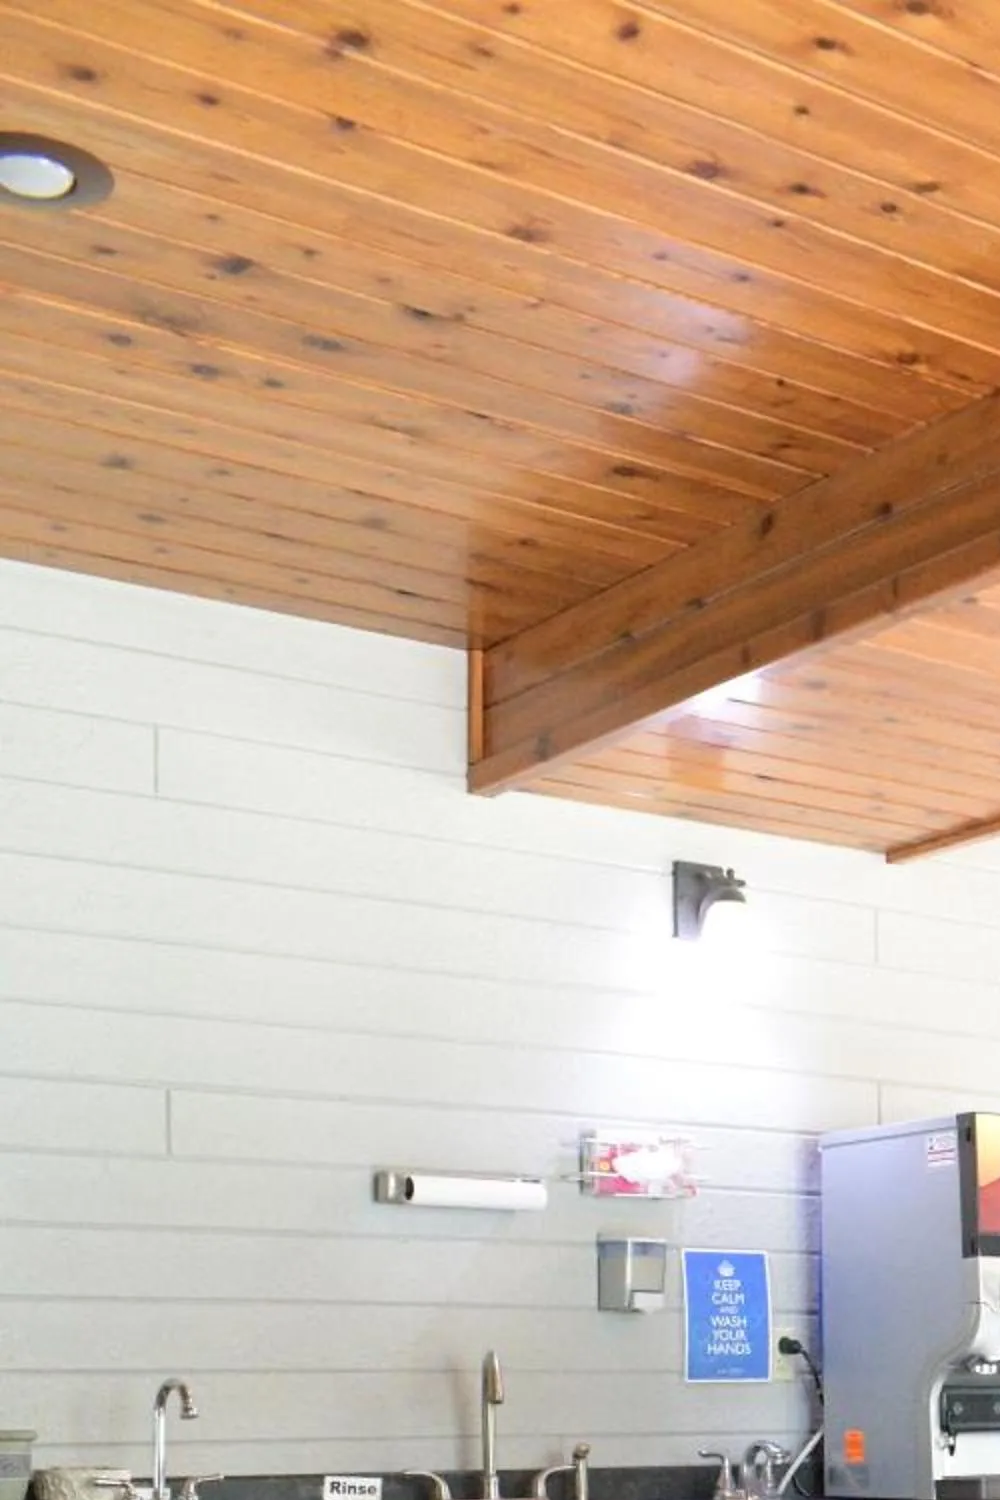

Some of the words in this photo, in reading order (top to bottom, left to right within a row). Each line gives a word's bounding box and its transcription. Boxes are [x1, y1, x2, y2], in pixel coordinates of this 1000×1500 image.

[713, 1279, 741, 1291] KEEP
[711, 1292, 745, 1305] CALM
[711, 1315, 747, 1328] WASH
[712, 1328, 745, 1341] YOUR
[706, 1342, 752, 1356] HANDS
[329, 1481, 377, 1495] Rinse
